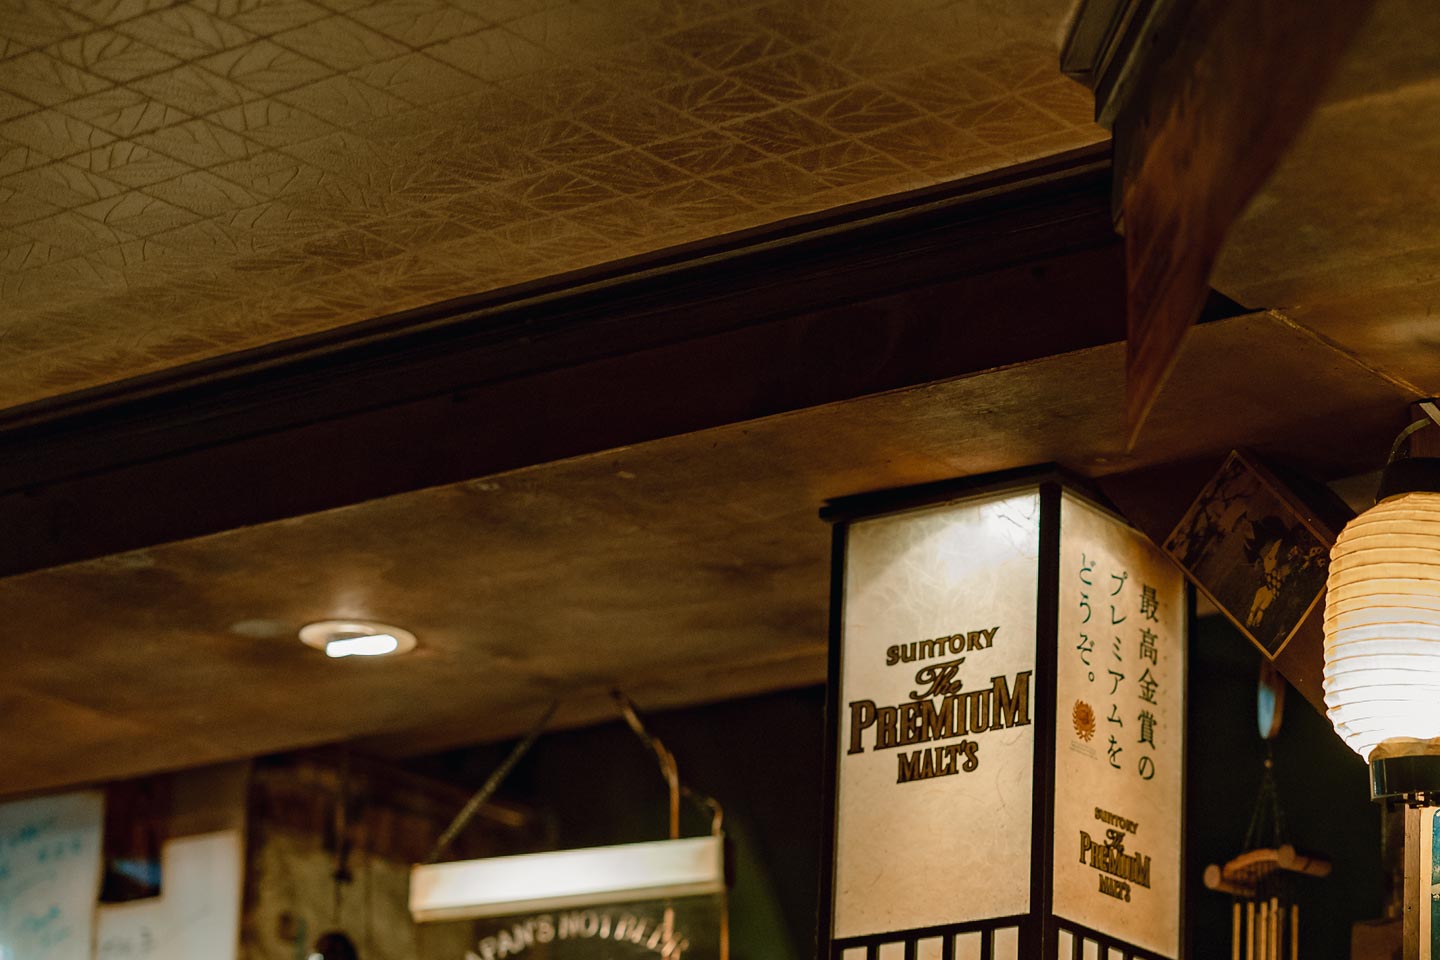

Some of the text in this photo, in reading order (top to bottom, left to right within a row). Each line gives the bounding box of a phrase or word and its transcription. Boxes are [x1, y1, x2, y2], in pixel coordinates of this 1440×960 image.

[886, 626, 1000, 666] SUNTORY
[1076, 553, 1095, 682] どうぞ。
[909, 657, 965, 701] The
[1107, 571, 1128, 769] プレミアムを
[1137, 582, 1159, 780] 最高金賞の
[847, 670, 1032, 755] PREMIUM
[896, 740, 979, 784] MALT'S
[1079, 830, 1151, 889] PREMIUM
